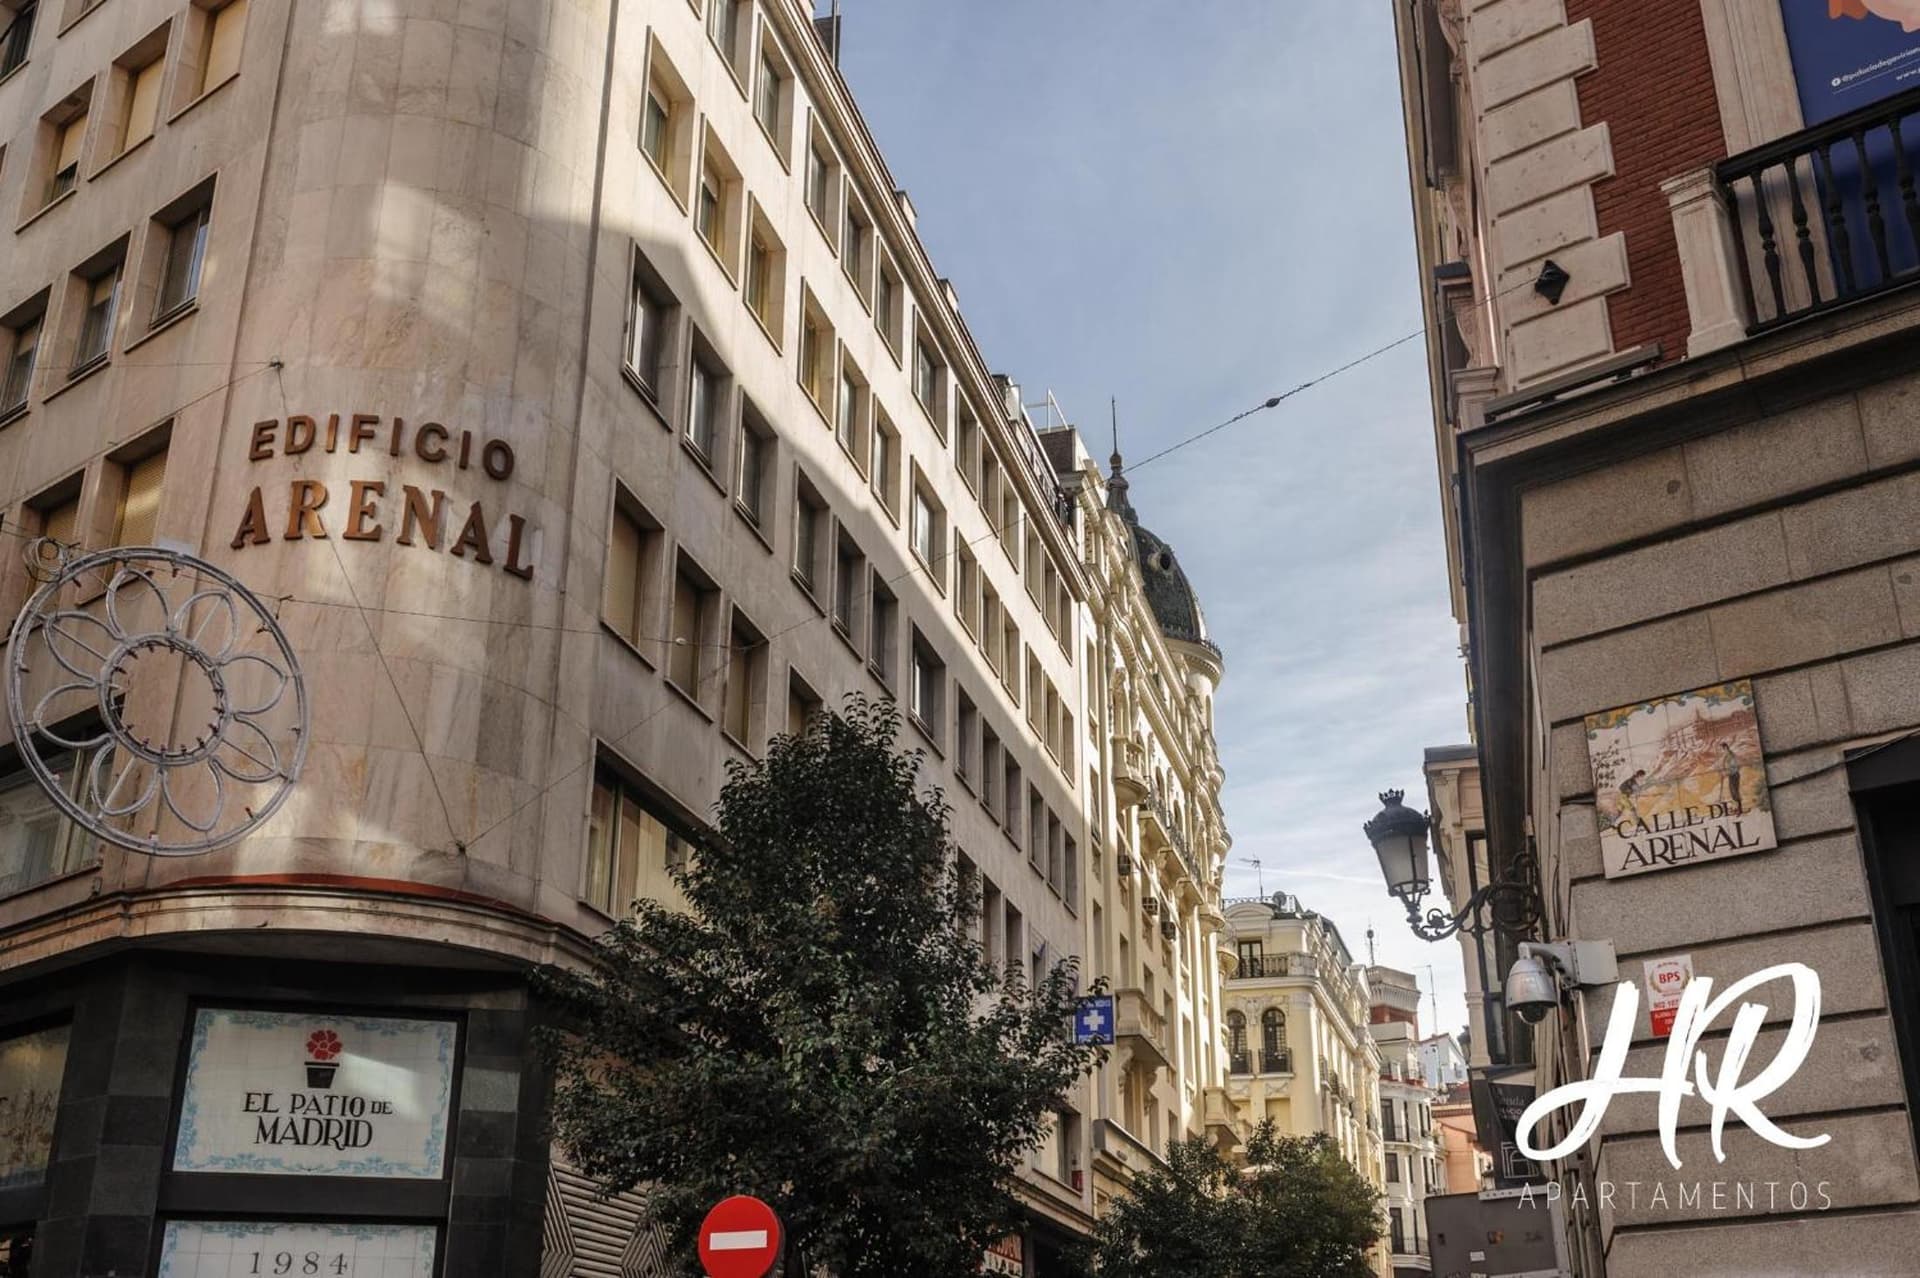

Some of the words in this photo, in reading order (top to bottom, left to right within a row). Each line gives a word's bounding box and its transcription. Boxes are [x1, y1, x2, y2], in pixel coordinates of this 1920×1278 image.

[249, 414, 514, 481] EDIFICIO
[231, 480, 534, 581] ARENAL
[1617, 806, 1704, 839] CALLE
[1708, 800, 1751, 819] DEL
[1619, 821, 1760, 872] ARENAL
[242, 1092, 280, 1113] EL
[289, 1094, 365, 1117] PATIO
[371, 1100, 392, 1115] DE
[253, 1116, 373, 1150] MADRID
[249, 1251, 348, 1275] 1984
